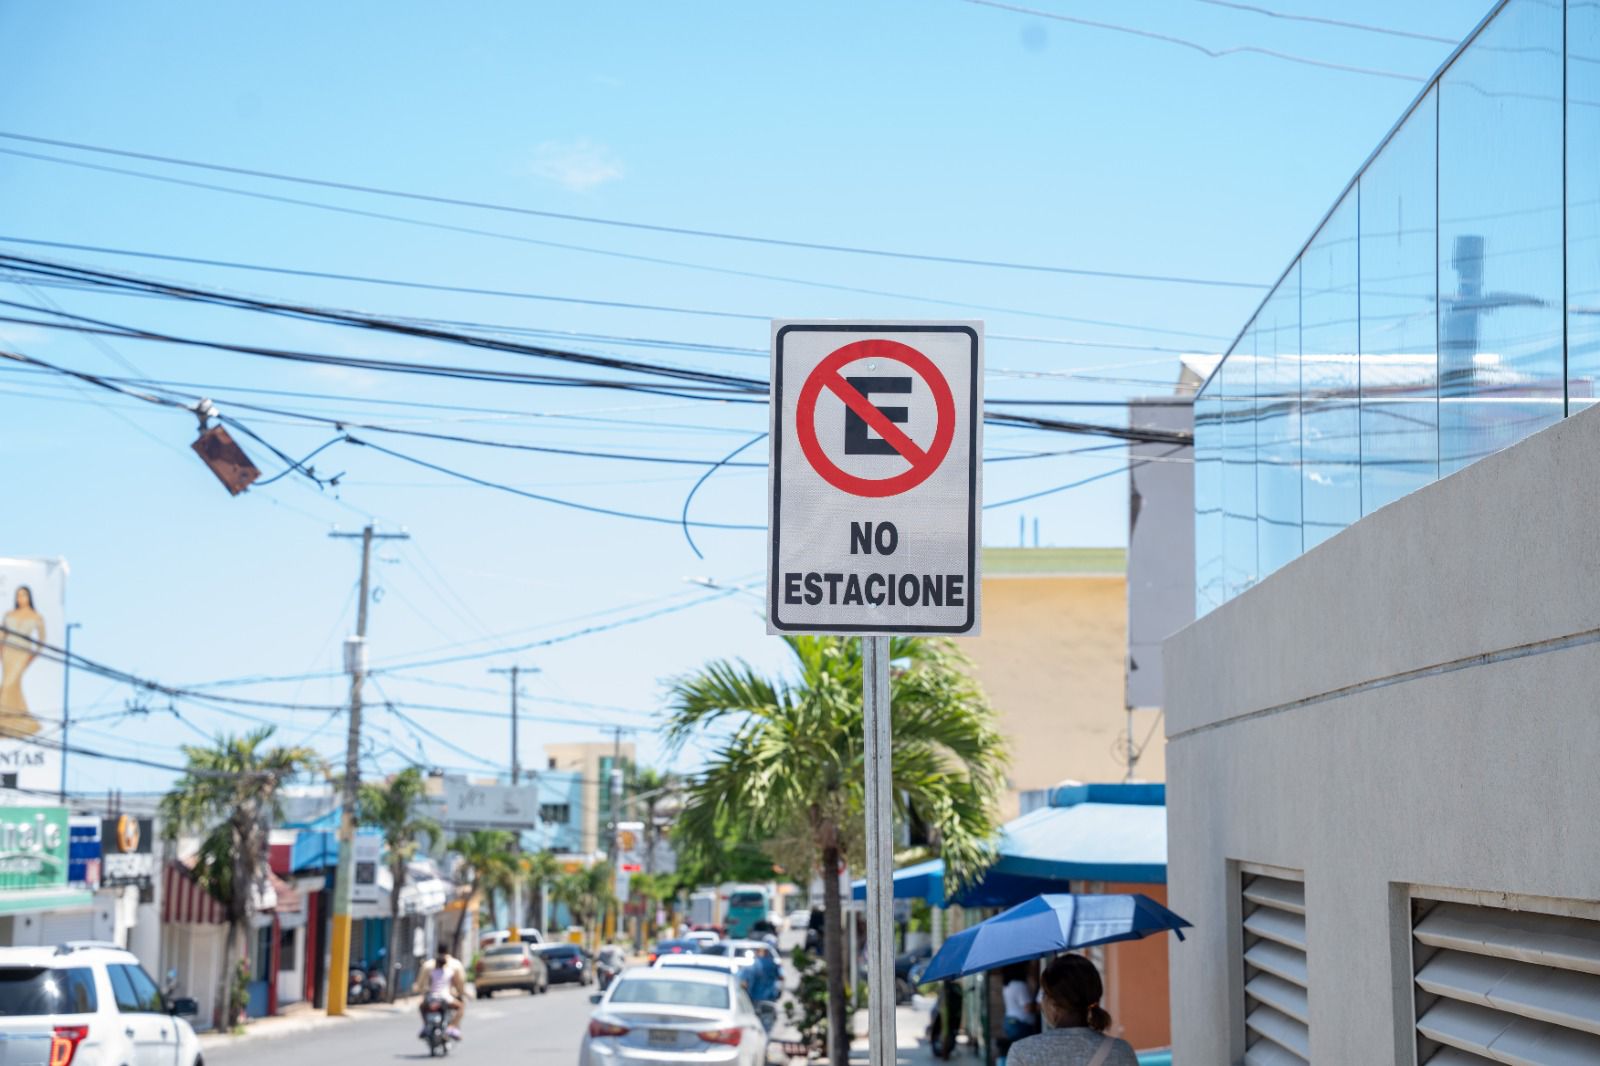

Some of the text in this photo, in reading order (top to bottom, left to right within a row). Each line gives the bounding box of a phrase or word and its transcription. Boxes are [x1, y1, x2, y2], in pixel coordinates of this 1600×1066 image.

[845, 377, 912, 455] E
[850, 521, 898, 556] NO
[785, 572, 963, 607] ESTACIONE
